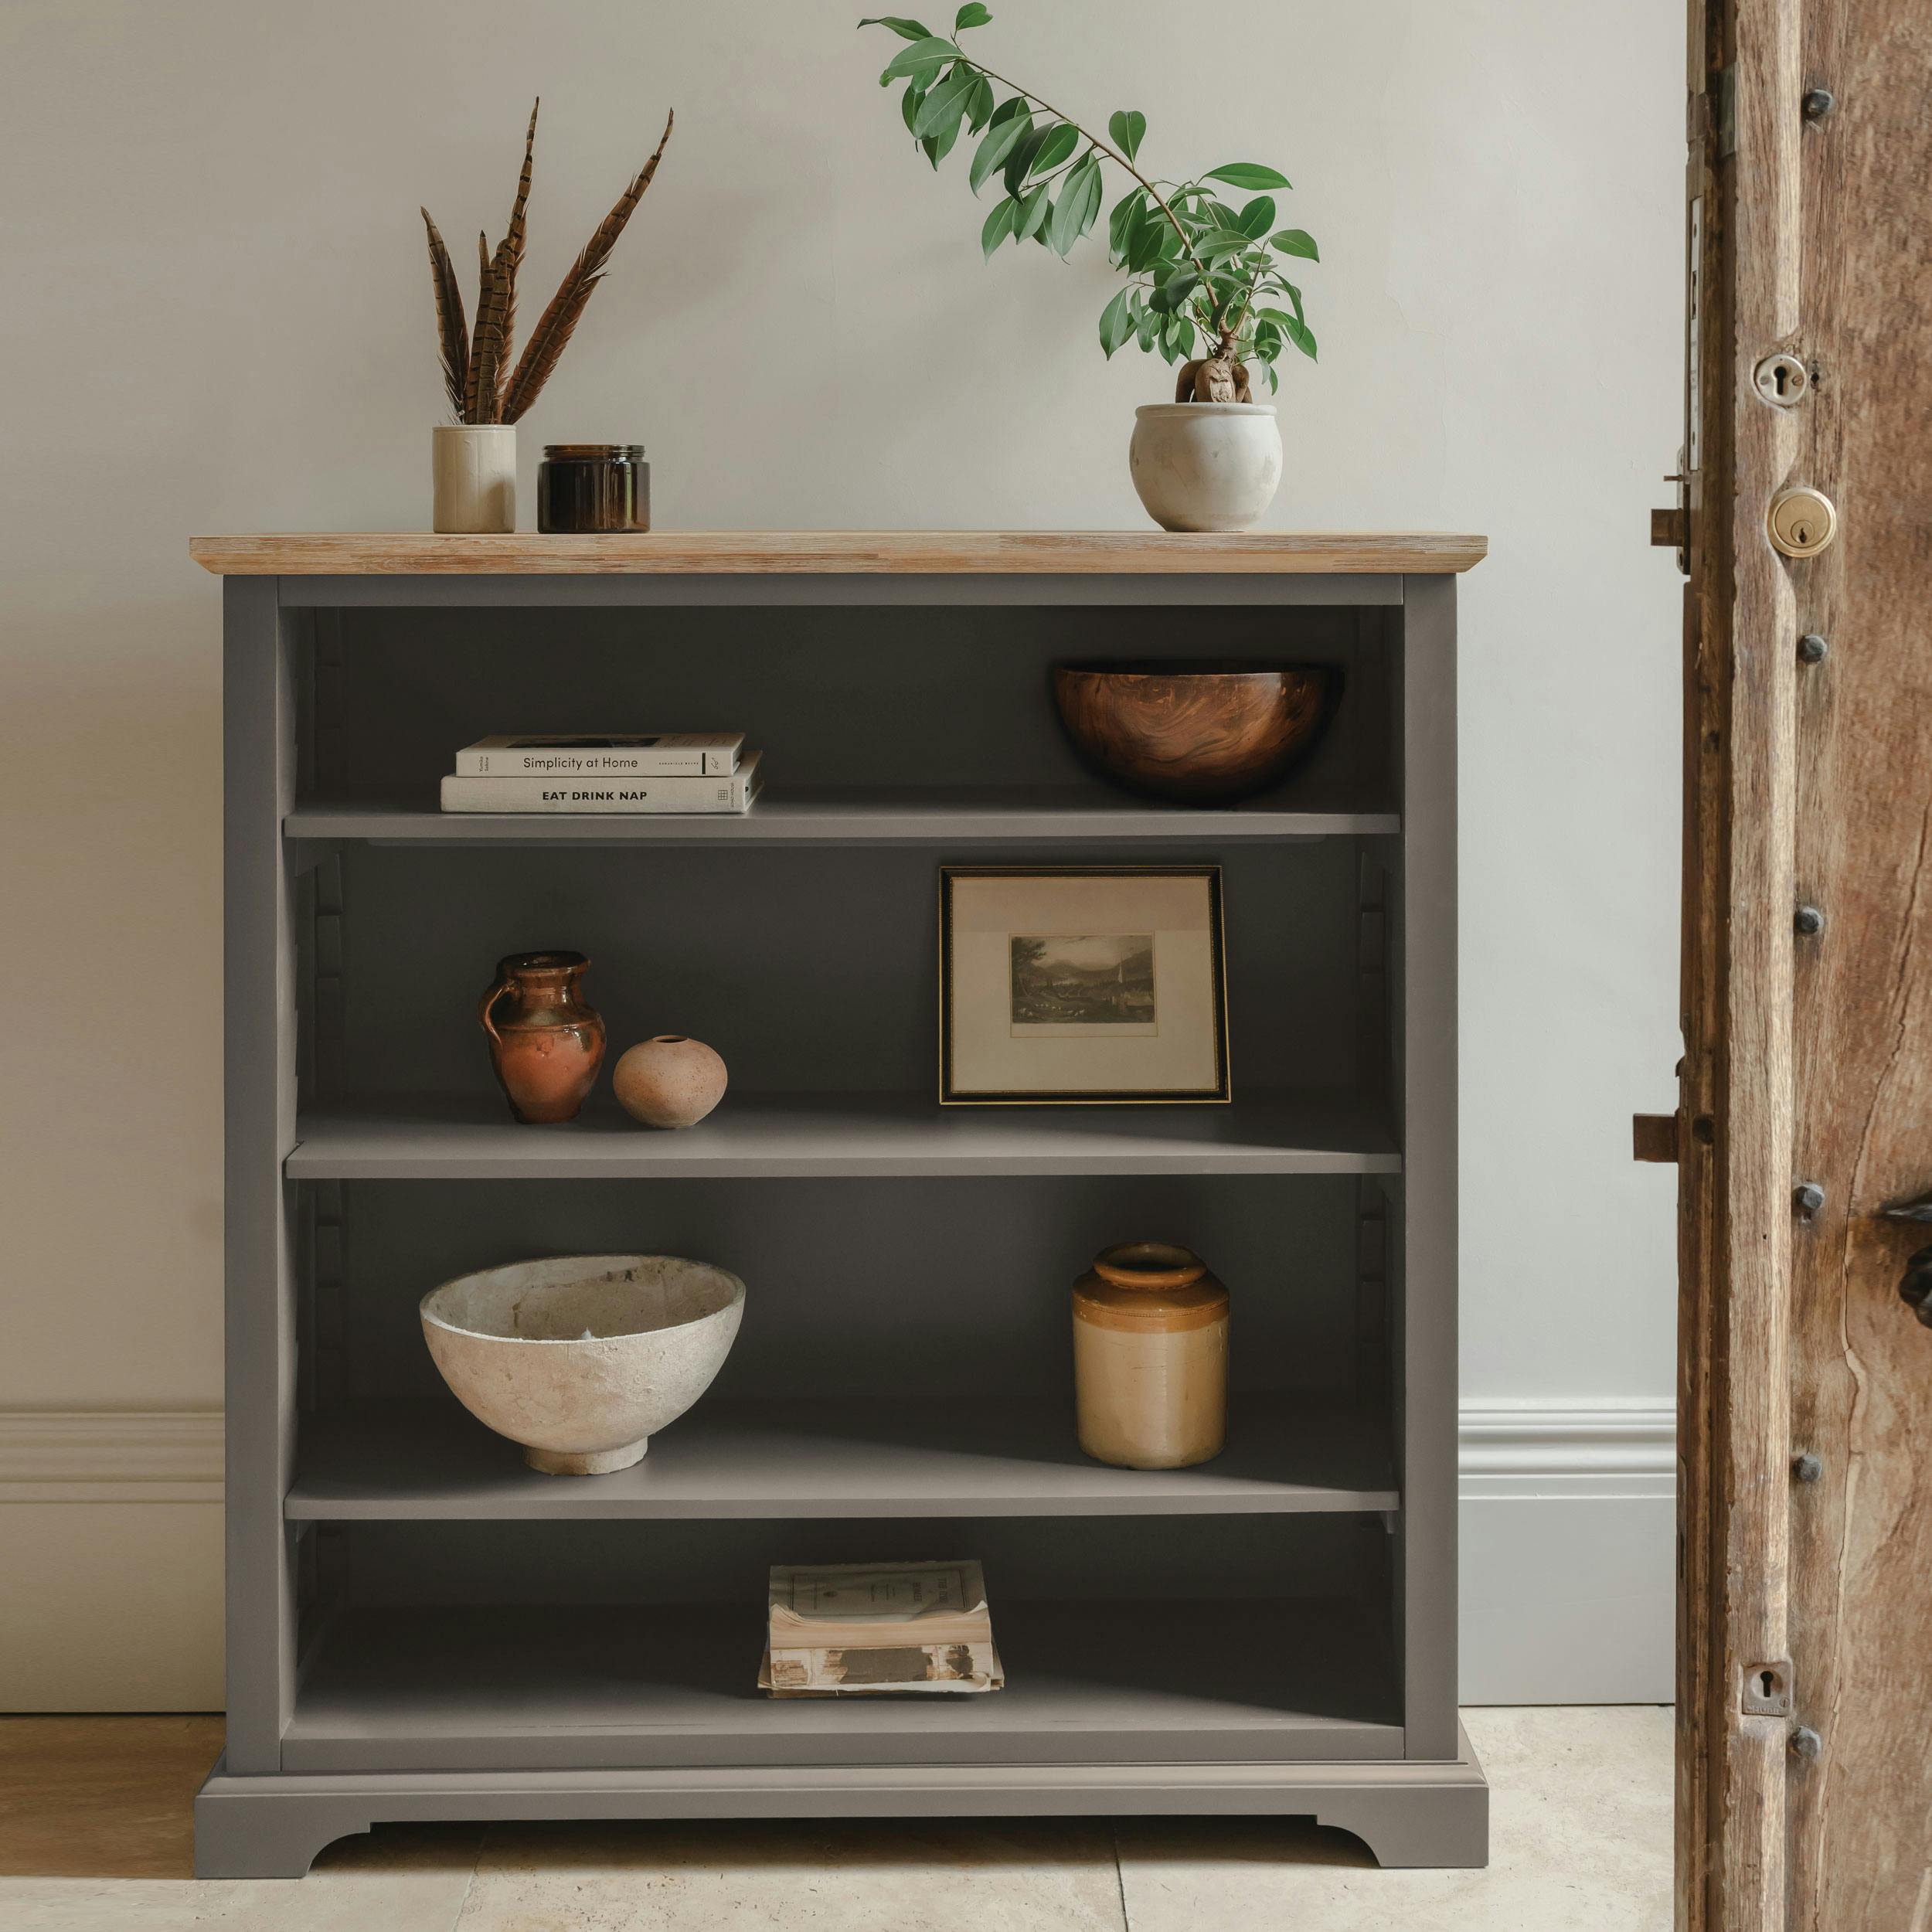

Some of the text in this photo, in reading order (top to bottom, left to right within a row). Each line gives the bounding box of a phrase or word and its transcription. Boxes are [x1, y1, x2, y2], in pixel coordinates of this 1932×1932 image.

[523, 757, 638, 770] Simplicity at Home
[543, 791, 648, 801] EAT DRINK NAP
